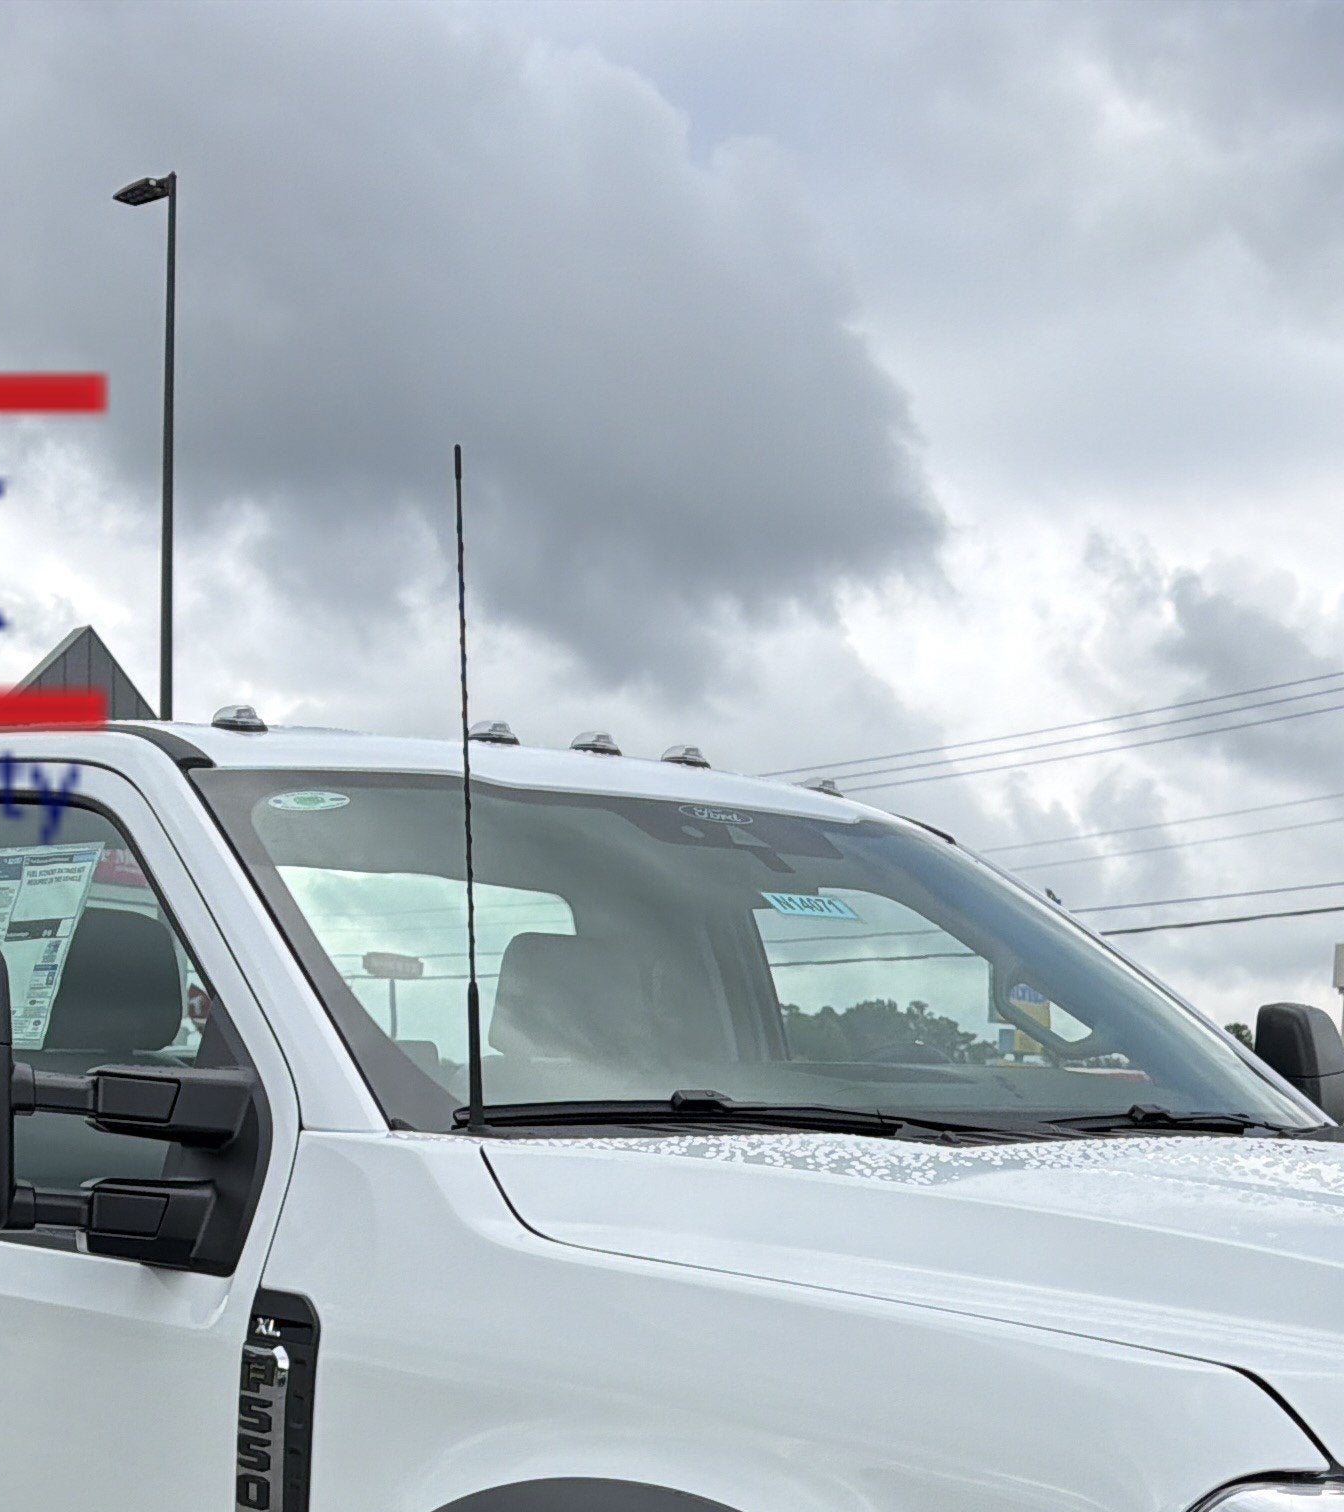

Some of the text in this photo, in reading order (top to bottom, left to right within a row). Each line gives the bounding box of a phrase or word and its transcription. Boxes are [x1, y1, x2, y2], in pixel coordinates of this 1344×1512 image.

[693, 806, 743, 823] Ford
[771, 894, 845, 915] N14071
[254, 1317, 281, 1337] XL
